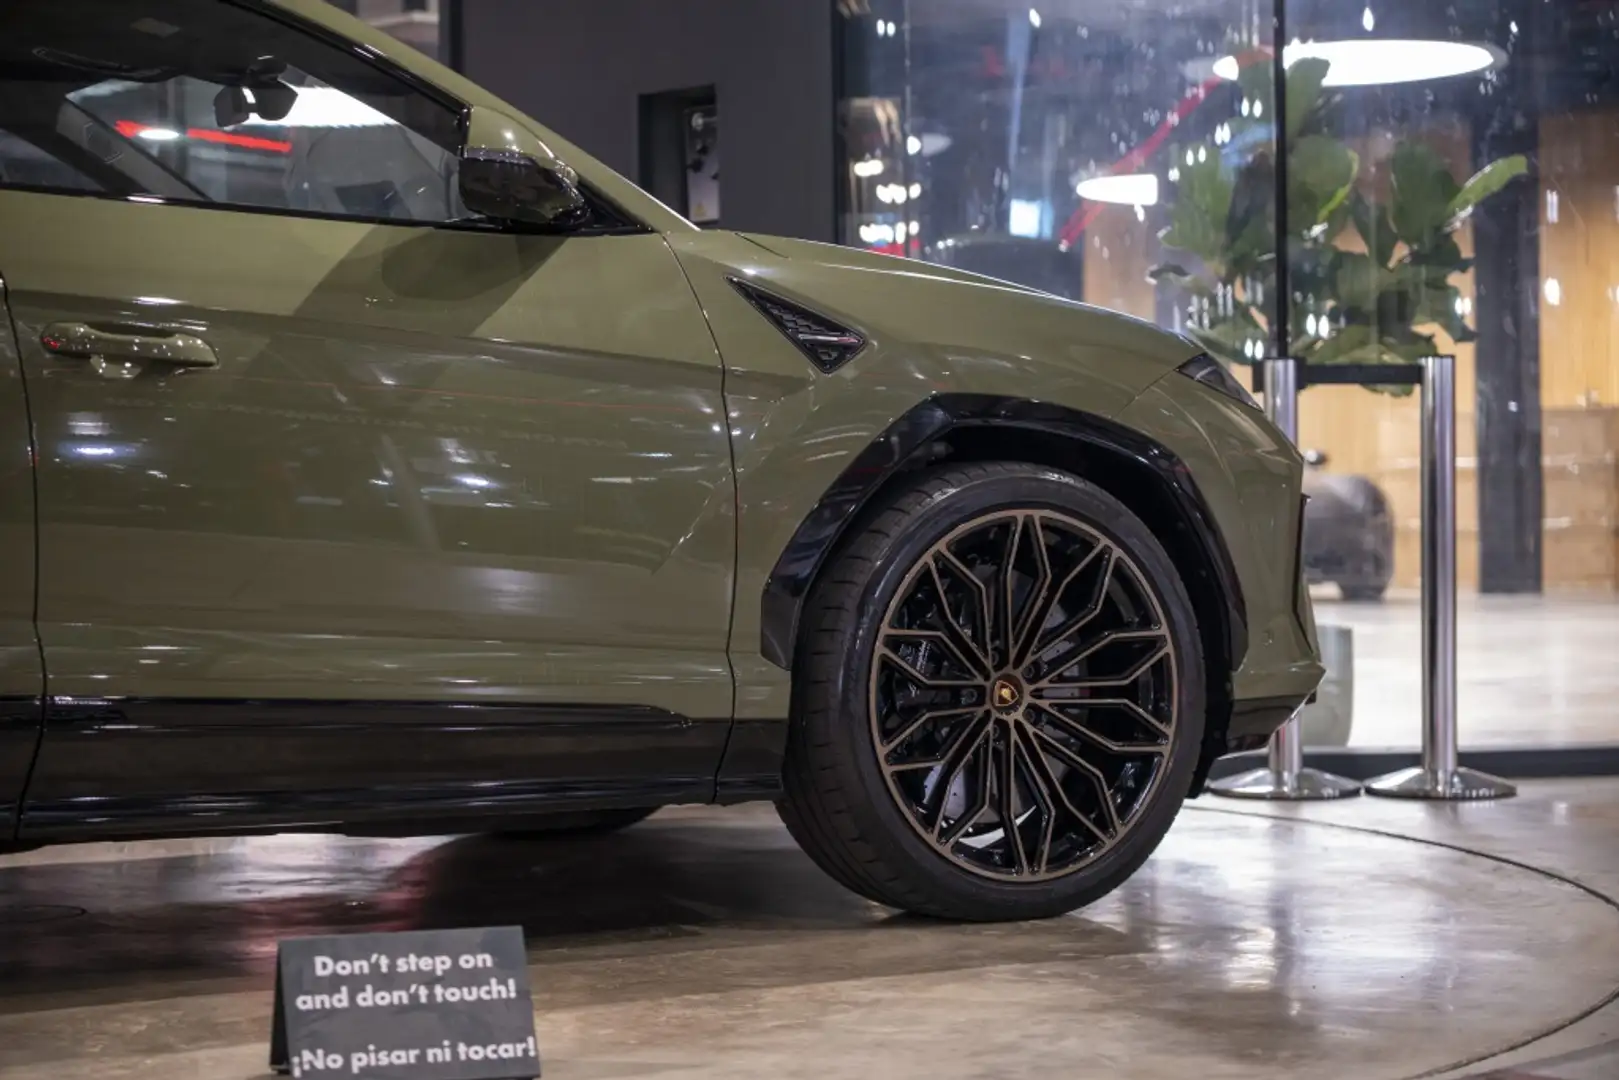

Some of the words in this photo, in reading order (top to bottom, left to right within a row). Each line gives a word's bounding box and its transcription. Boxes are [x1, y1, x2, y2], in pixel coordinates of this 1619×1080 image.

[314, 953, 390, 977] Don't
[396, 953, 452, 976] step
[458, 953, 493, 970] on
[295, 985, 349, 1010] and
[356, 983, 429, 1008] don't
[434, 977, 517, 1003] touch!
[291, 1049, 344, 1078] ¡No
[351, 1044, 420, 1074] pisar
[426, 1040, 452, 1064] ni
[458, 1036, 536, 1062] tocar!
